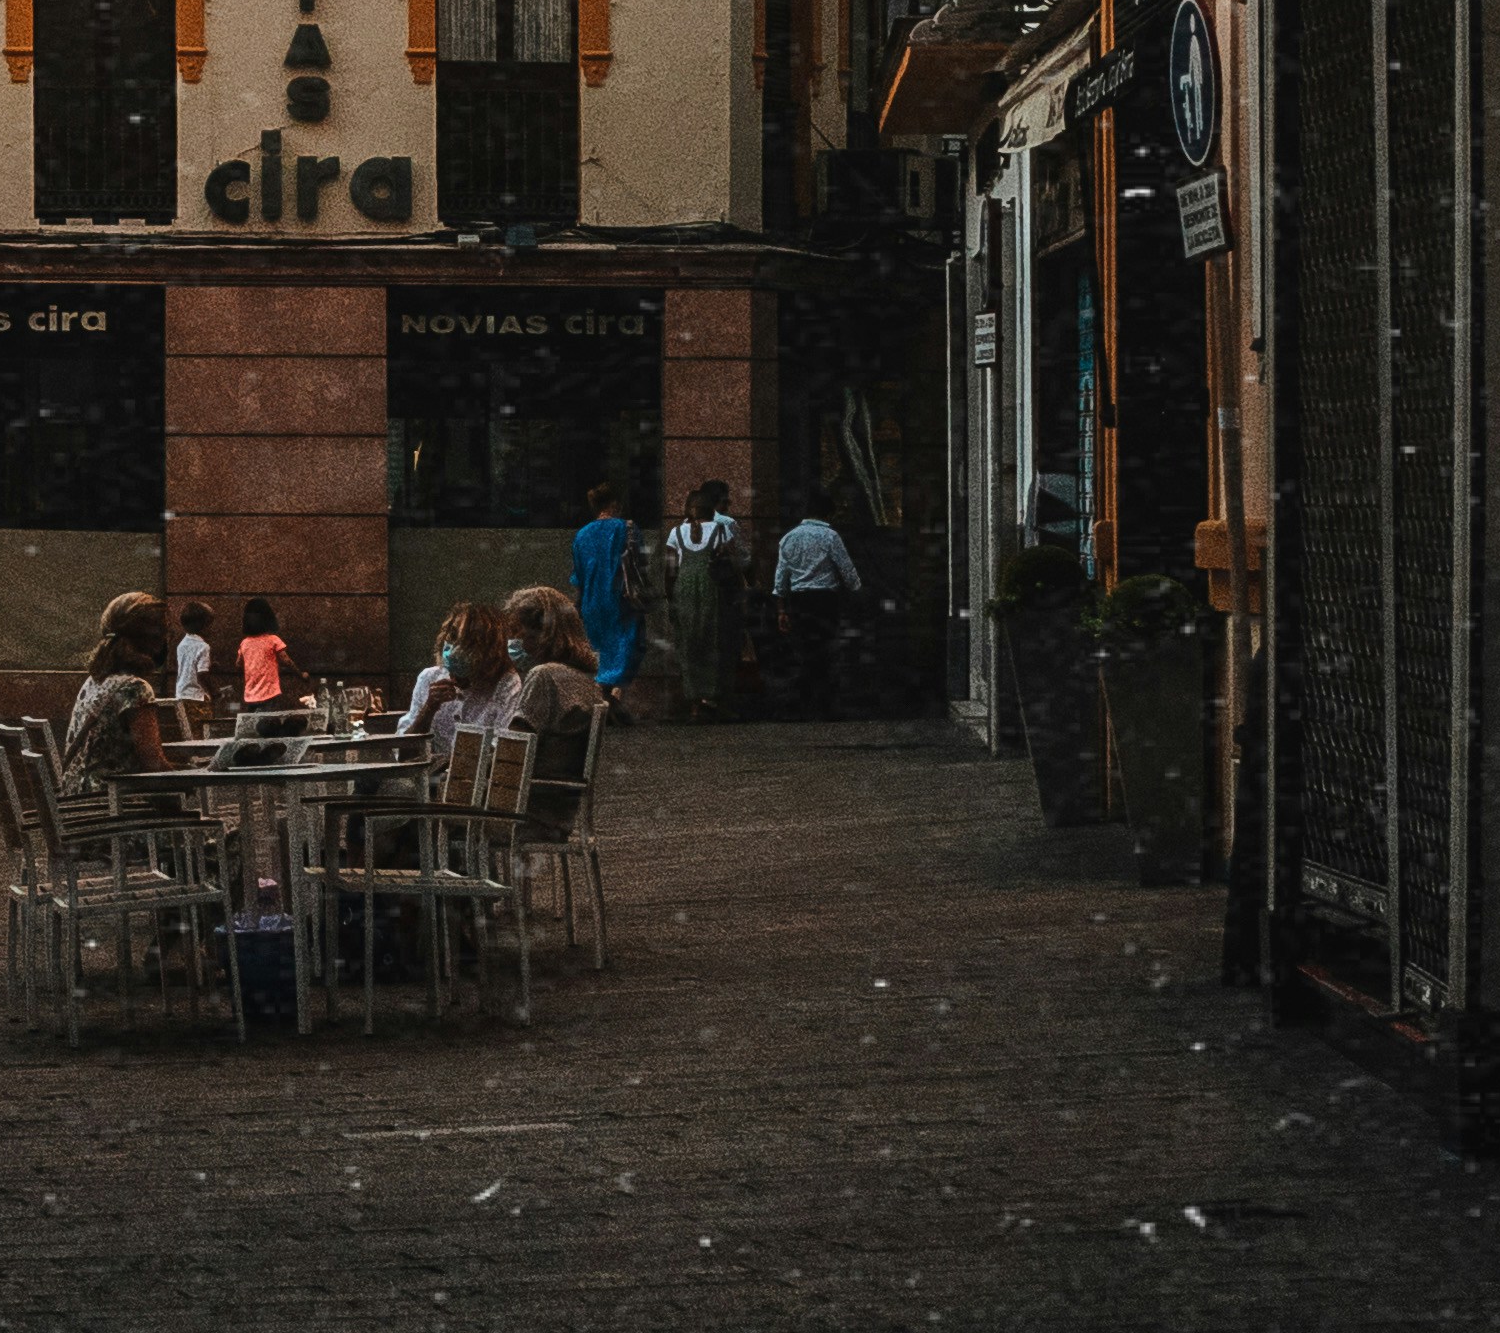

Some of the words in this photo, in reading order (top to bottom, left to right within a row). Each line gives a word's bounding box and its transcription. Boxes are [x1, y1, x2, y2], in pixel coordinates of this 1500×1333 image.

[205, 130, 412, 223] cira
[28, 305, 108, 333] cira
[401, 313, 548, 335] NOVIAS
[566, 308, 645, 335] cira
